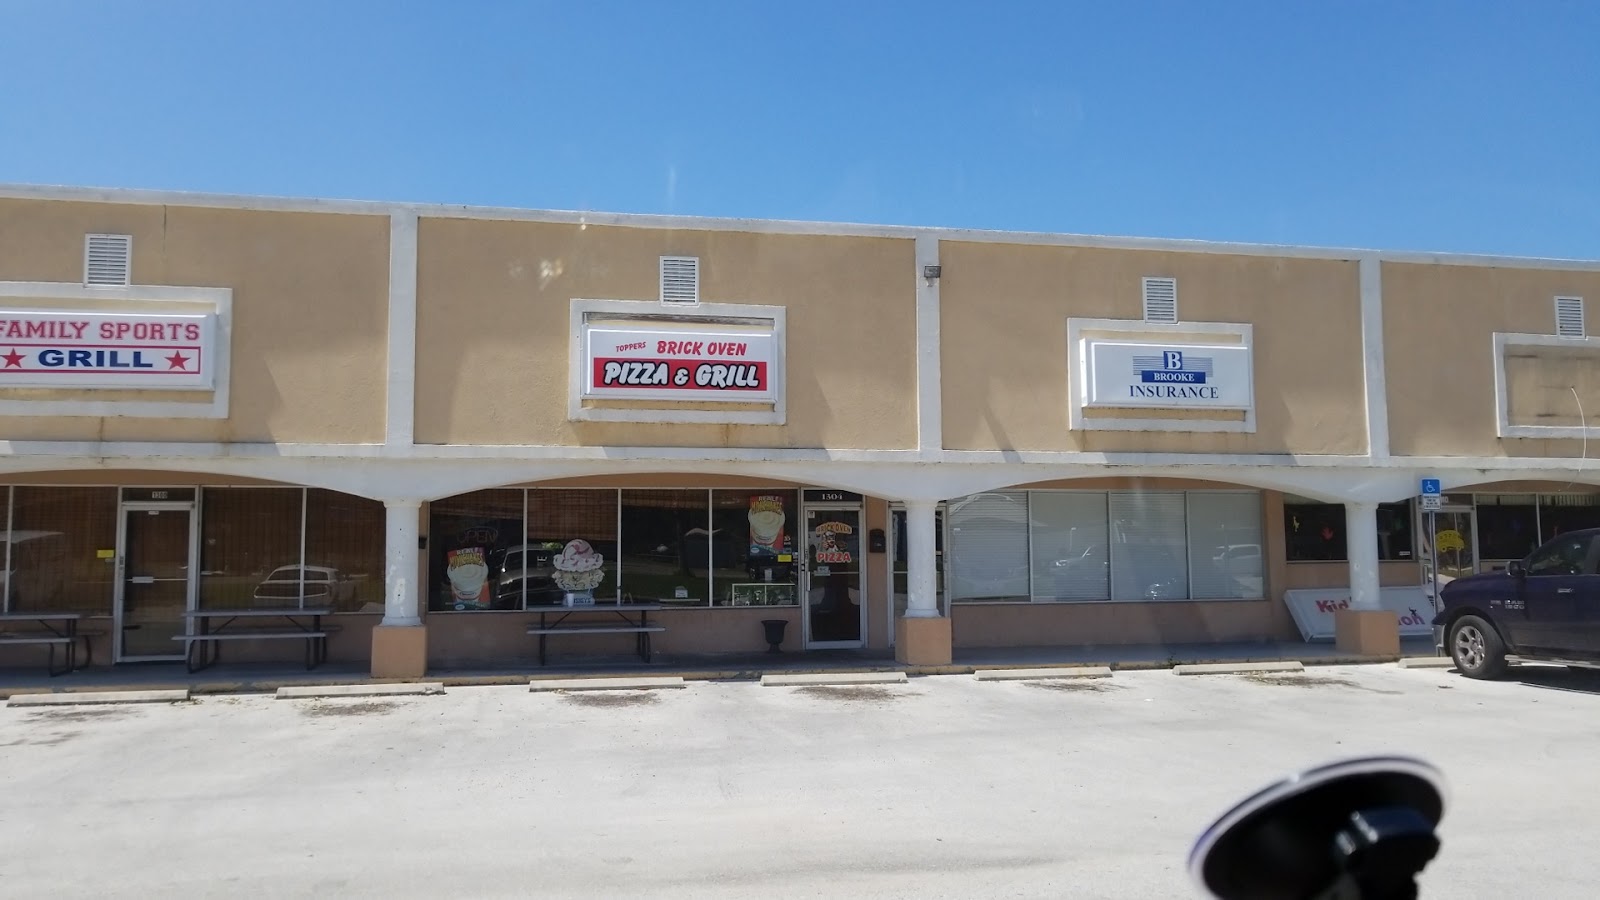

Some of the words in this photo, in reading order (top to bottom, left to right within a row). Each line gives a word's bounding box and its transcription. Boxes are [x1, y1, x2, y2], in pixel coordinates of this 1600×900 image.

[99, 322, 200, 341] SPORTS
[616, 342, 646, 352] TOPPERS
[656, 340, 704, 356] BRICK
[707, 342, 747, 356] OVEN
[37, 350, 153, 368] GRILL
[1166, 352, 1181, 369] B
[603, 362, 669, 385] PIZZA
[673, 367, 690, 386] &
[694, 363, 760, 388] GRILL
[1154, 373, 1194, 382] BROOKE
[1130, 386, 1218, 399] INSURANCE
[817, 552, 851, 562] PIZZA
